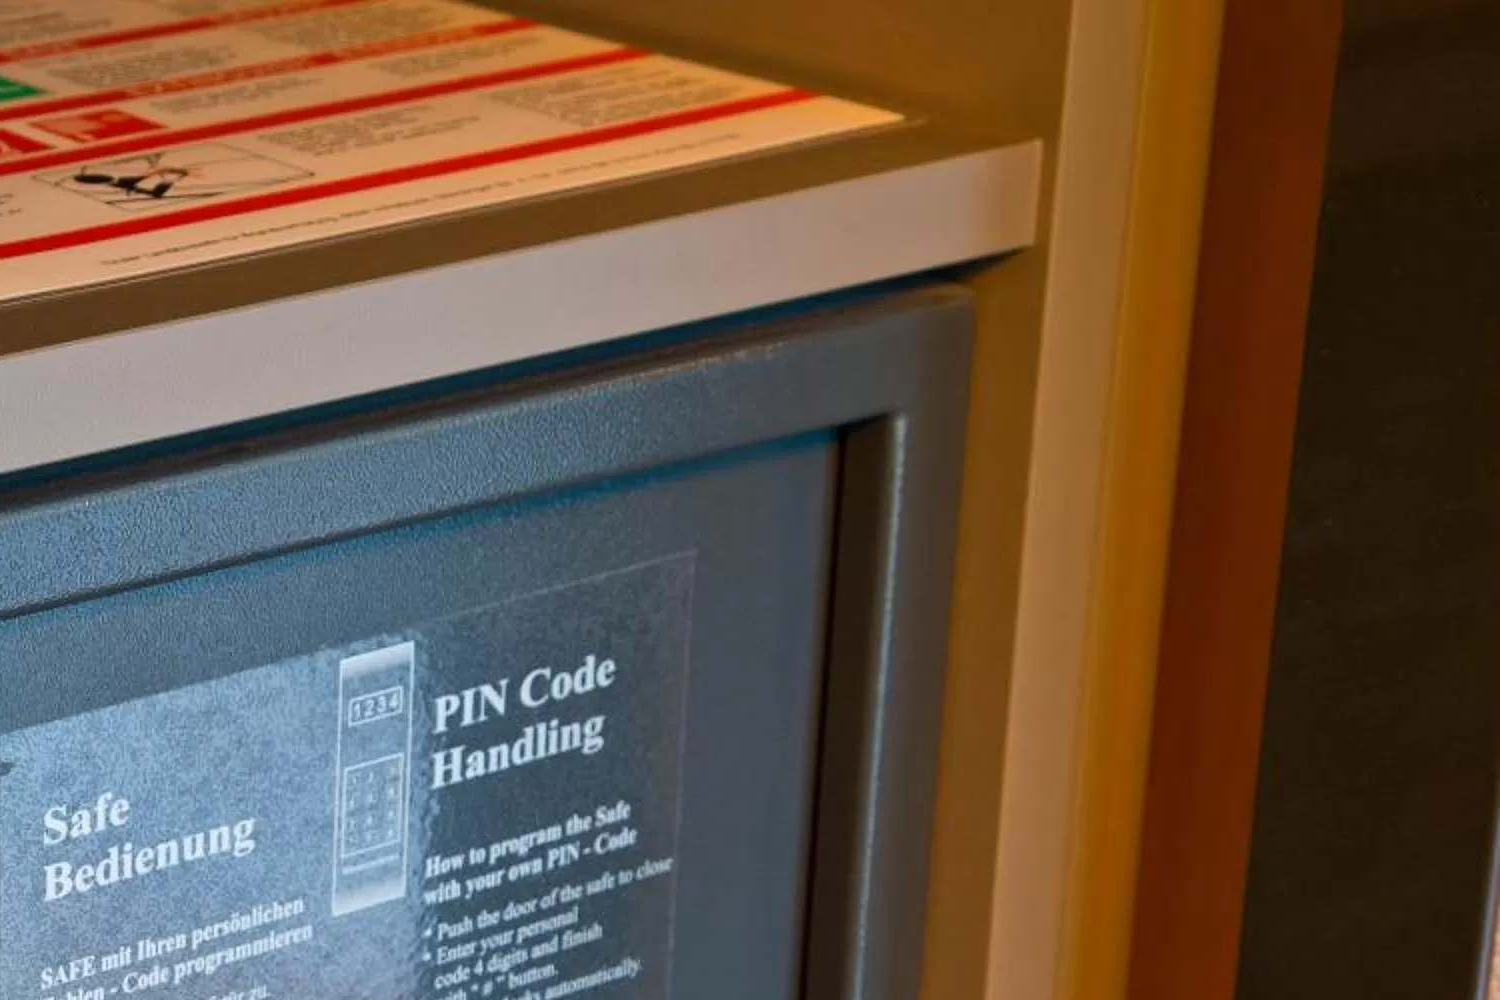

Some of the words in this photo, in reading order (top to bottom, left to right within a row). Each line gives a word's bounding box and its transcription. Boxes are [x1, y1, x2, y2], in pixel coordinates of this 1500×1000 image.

[353, 693, 398, 718] 1234
[432, 679, 508, 732] PIN
[520, 655, 616, 708] Code
[431, 716, 605, 787] Handling
[43, 792, 129, 844] Safe
[425, 854, 464, 878] How
[468, 844, 486, 865] to
[490, 825, 561, 864] program
[565, 813, 592, 837] the
[595, 801, 631, 828] Safe
[44, 818, 256, 899] Bedienung
[423, 877, 460, 906] with
[464, 869, 503, 900] your
[507, 858, 542, 881] own
[547, 842, 578, 869] PIN
[595, 827, 637, 854] Code
[436, 941, 476, 964] Enter
[479, 929, 514, 955] your
[516, 906, 578, 944] personal
[437, 914, 472, 940] Push
[477, 908, 500, 928] the
[502, 899, 536, 921] door
[540, 888, 558, 909] of
[559, 883, 582, 903] the
[585, 873, 614, 895] safe
[618, 868, 632, 885] to
[635, 857, 673, 880] close
[40, 955, 95, 989] SAFE
[102, 944, 131, 970] mit
[138, 933, 187, 960] Ihren
[192, 899, 304, 948] persönlichen
[122, 967, 169, 994] Code
[174, 925, 313, 983] programmieren
[433, 966, 470, 989] code
[486, 947, 528, 973] digits
[530, 936, 558, 959] and
[561, 922, 602, 949] finish
